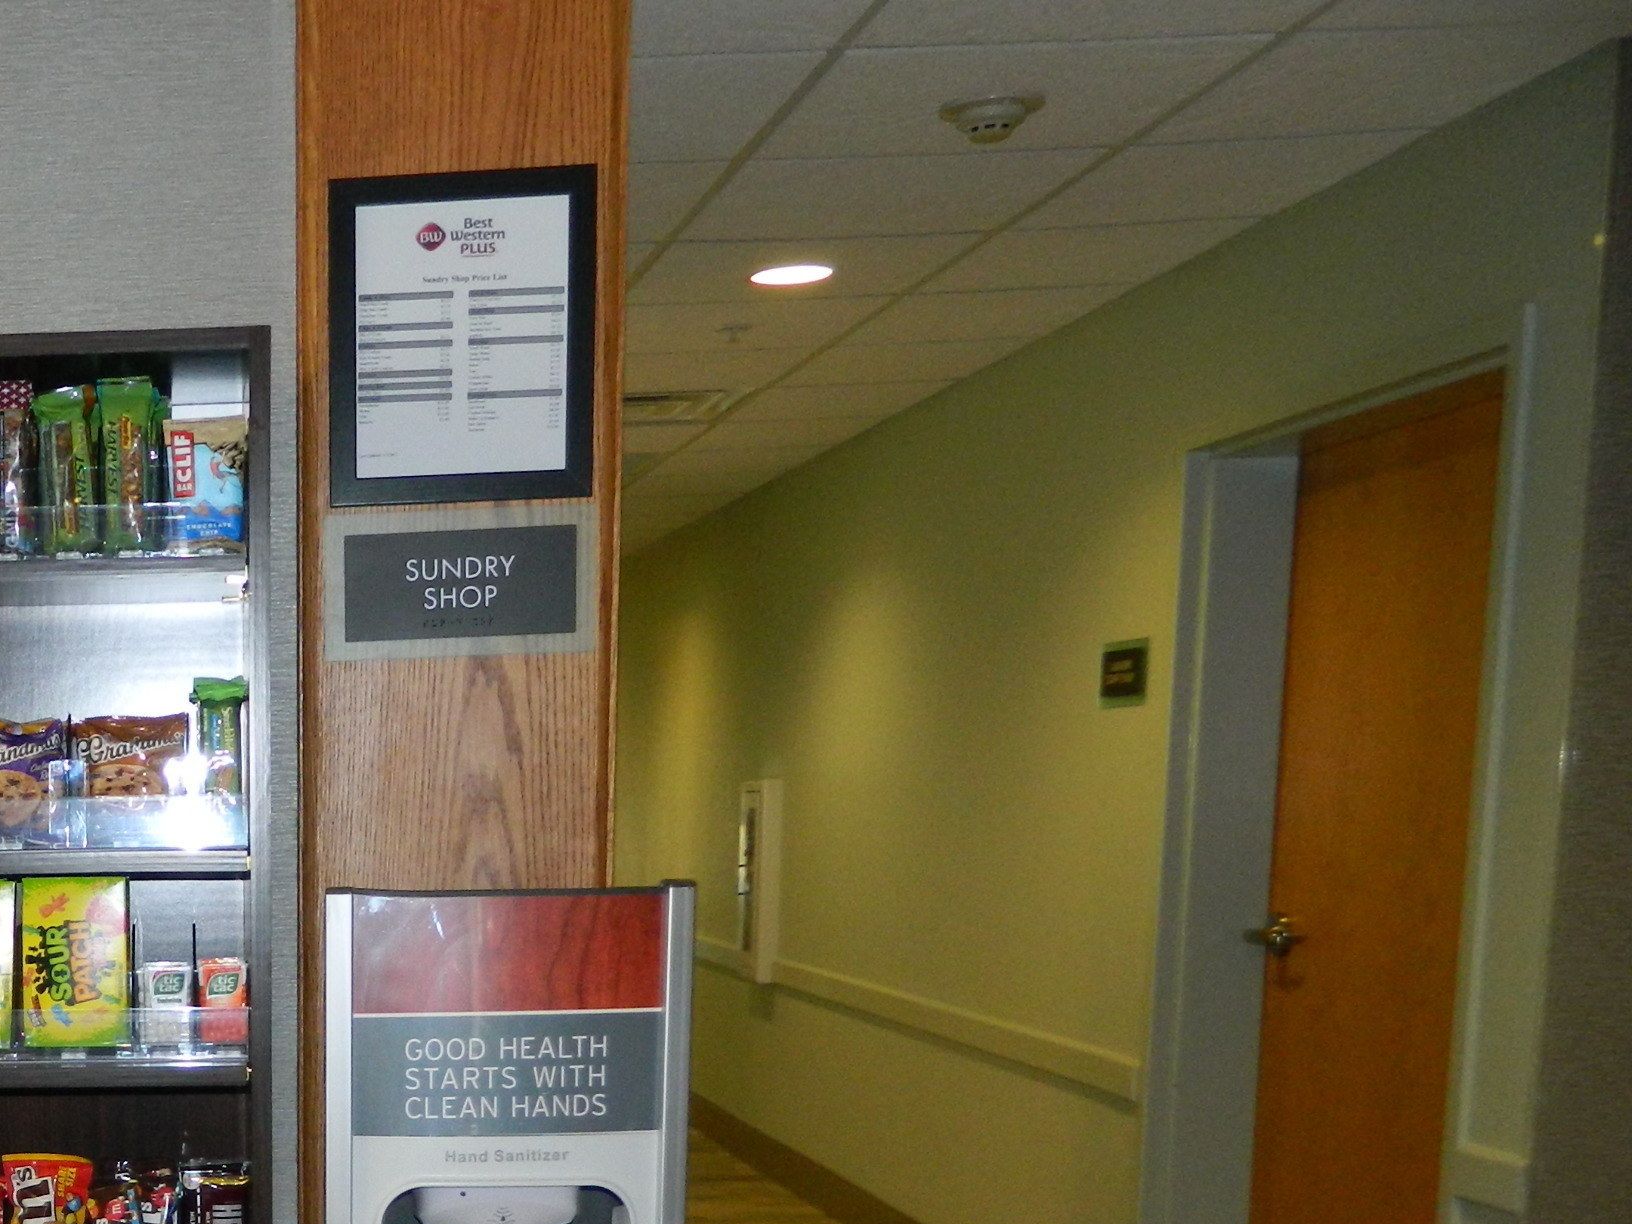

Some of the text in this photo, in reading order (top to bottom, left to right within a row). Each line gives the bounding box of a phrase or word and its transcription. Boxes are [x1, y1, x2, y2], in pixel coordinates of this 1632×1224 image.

[450, 230, 505, 241] Western
[464, 217, 493, 229] Best
[460, 242, 496, 254] PLUS
[174, 434, 193, 482] CLIF
[405, 555, 515, 582] SUNDRY
[423, 585, 498, 610] SHOP
[46, 927, 72, 1001] SOUR
[69, 921, 99, 1002] PATCH
[159, 983, 180, 992] tac
[213, 983, 234, 992] tac
[218, 974, 236, 984] tic
[405, 1036, 608, 1061] GOOD HEALTH
[405, 1065, 606, 1090] STARTS WITH
[405, 1094, 607, 1119] CLEAN HANDS
[445, 1148, 570, 1164] Hand Sanitizer
